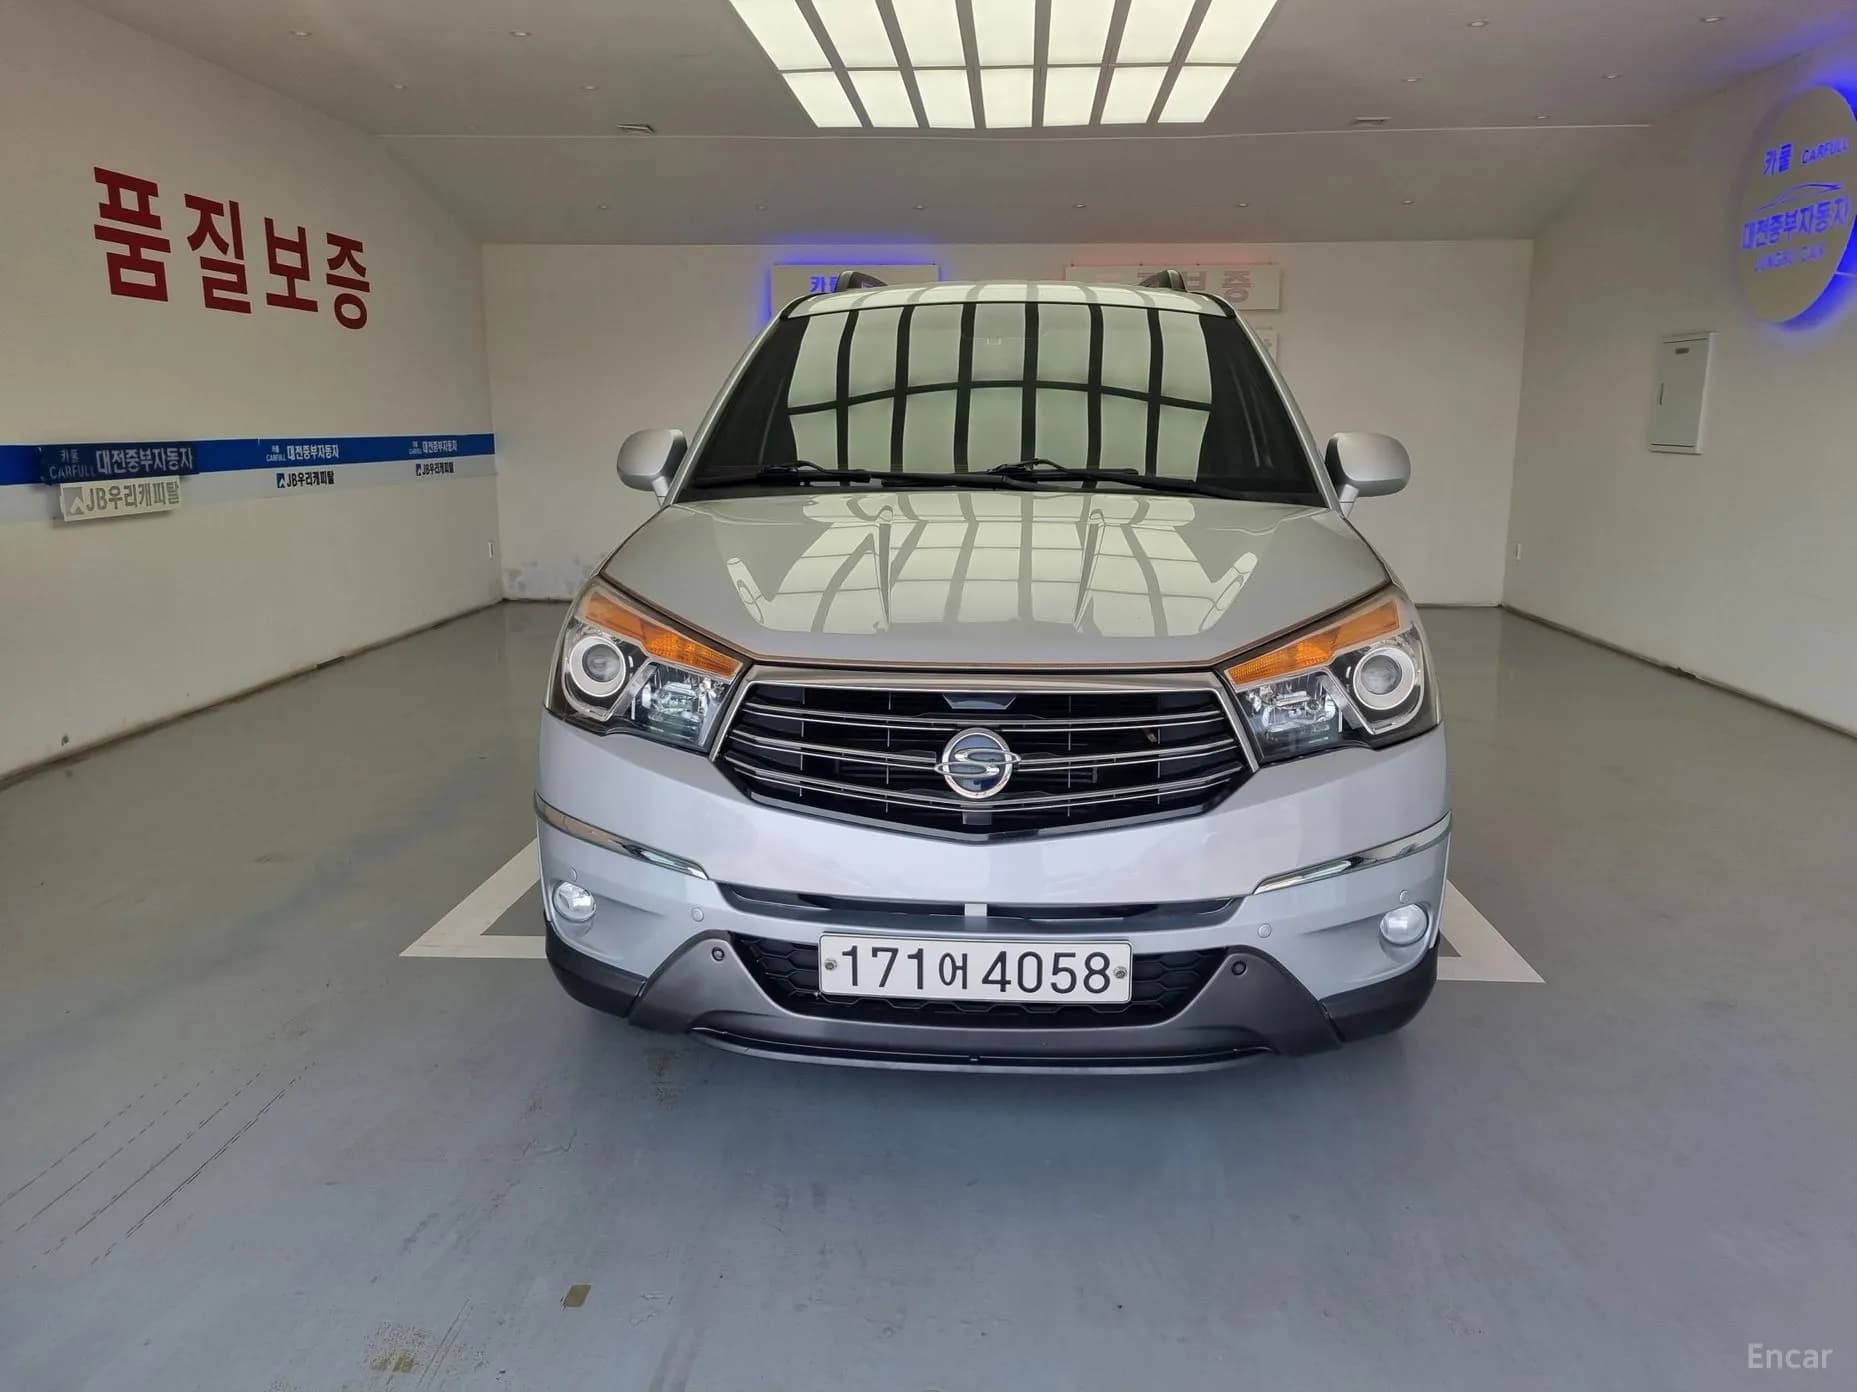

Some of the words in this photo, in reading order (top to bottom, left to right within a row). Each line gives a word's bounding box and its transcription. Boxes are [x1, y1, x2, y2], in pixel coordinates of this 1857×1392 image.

[94, 166, 370, 330] 품질보증
[49, 464, 96, 480] CARFULL
[286, 470, 335, 488] JB우리캐피탈
[86, 480, 180, 512] JB우리캐피탈
